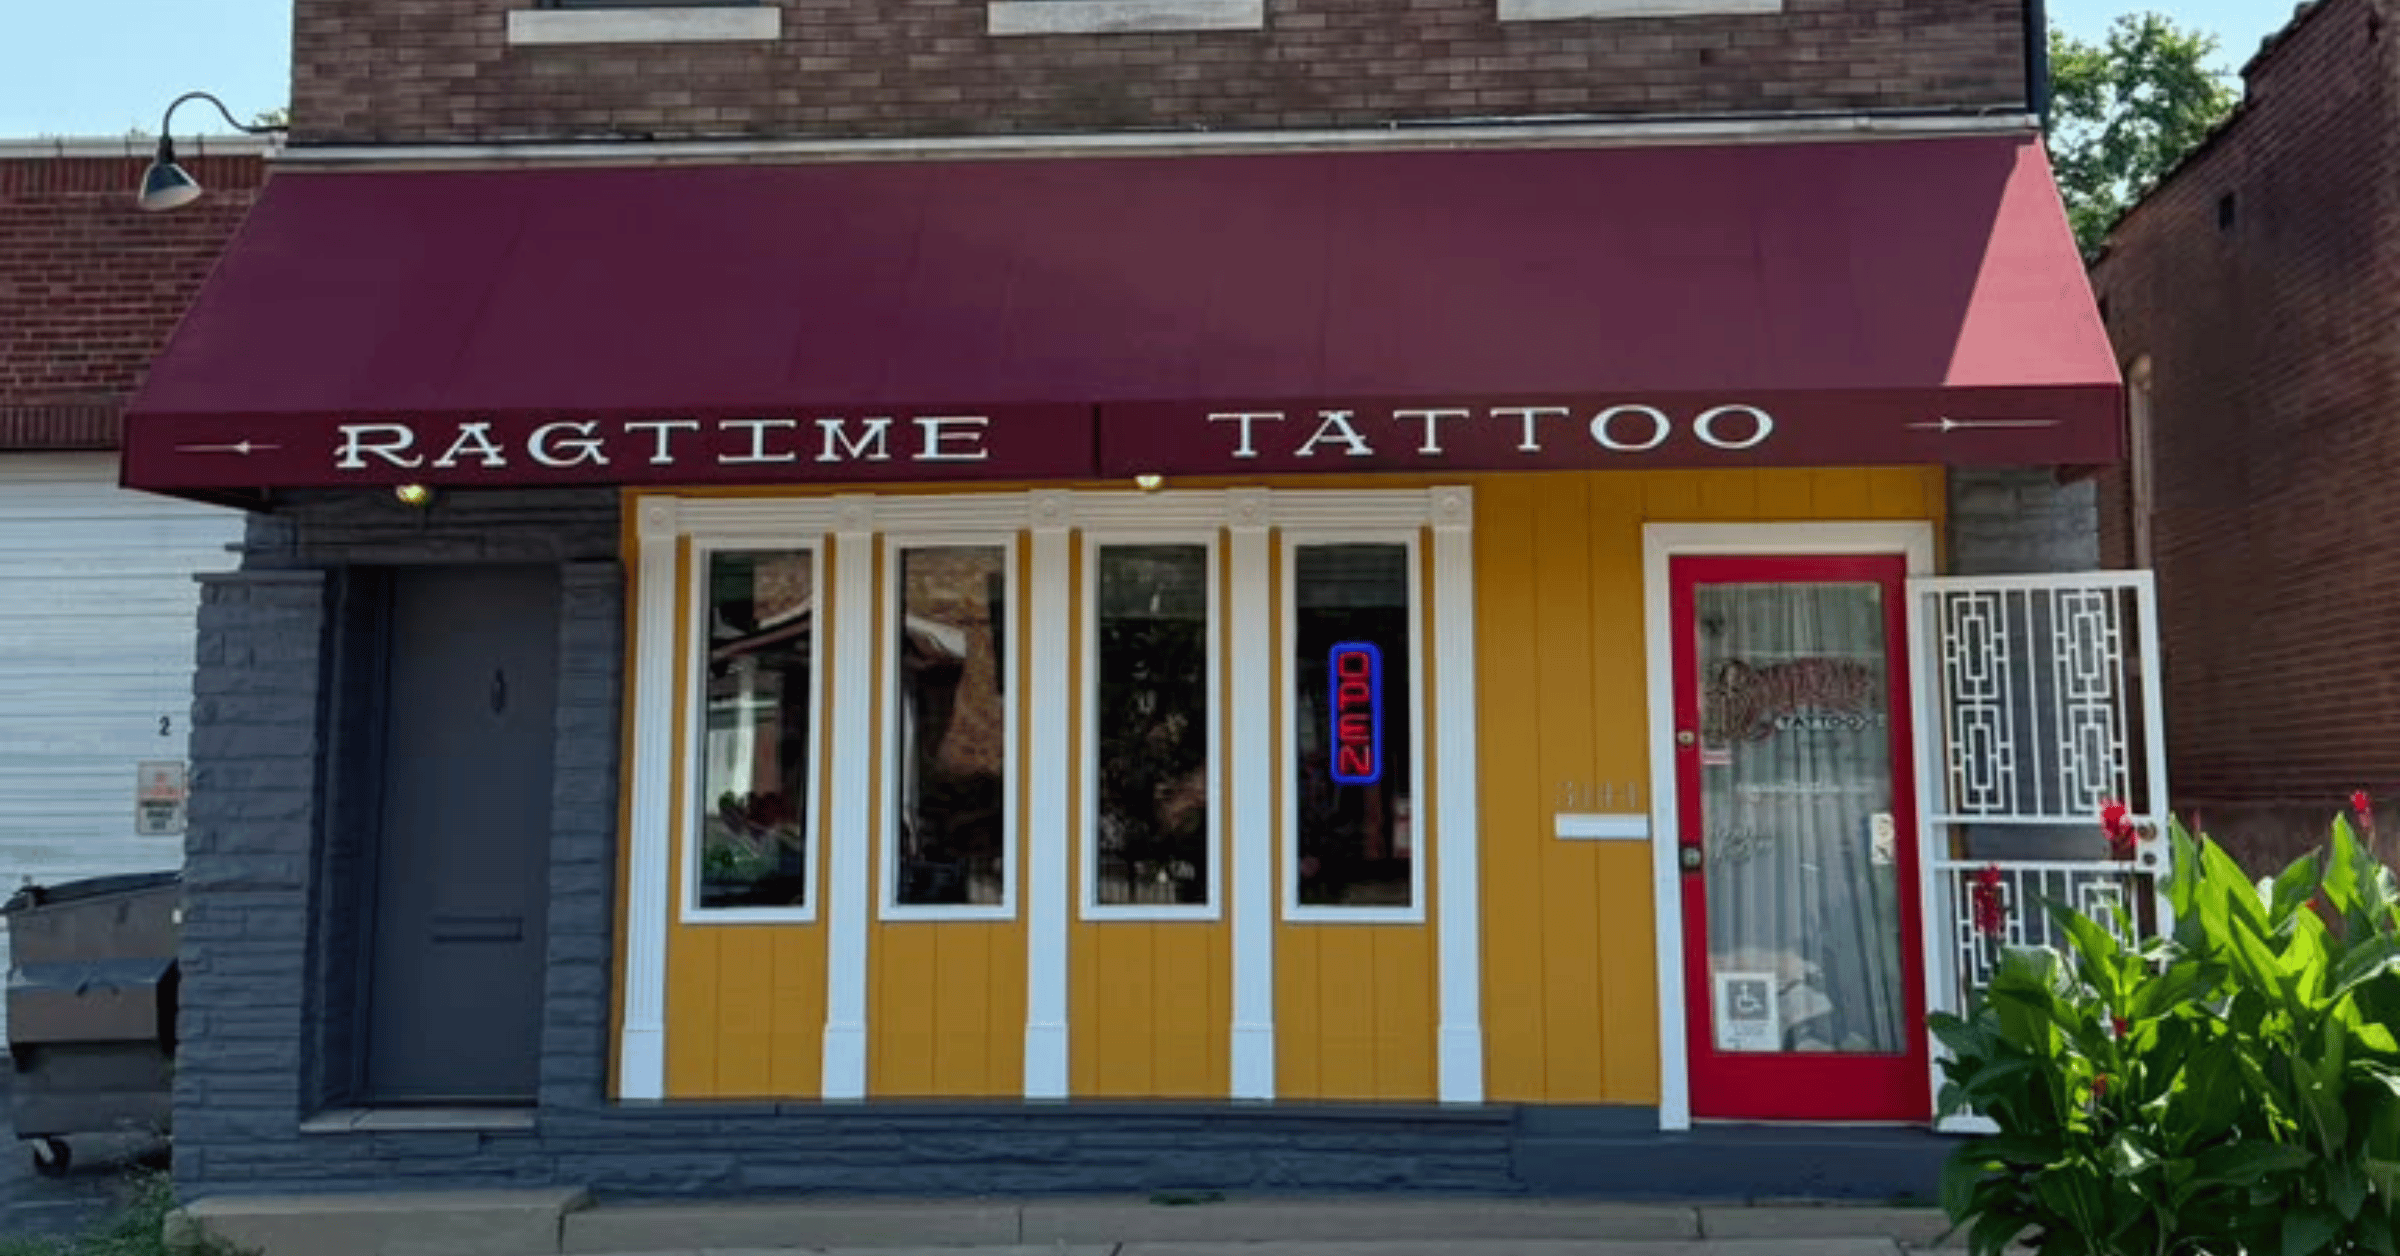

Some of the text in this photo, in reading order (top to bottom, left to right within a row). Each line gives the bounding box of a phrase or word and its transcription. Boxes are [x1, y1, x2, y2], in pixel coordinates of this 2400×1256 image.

[336, 405, 1772, 467] RAGTIME TATTOO
[159, 716, 170, 736] 2
[1339, 652, 1370, 773] OPEN
